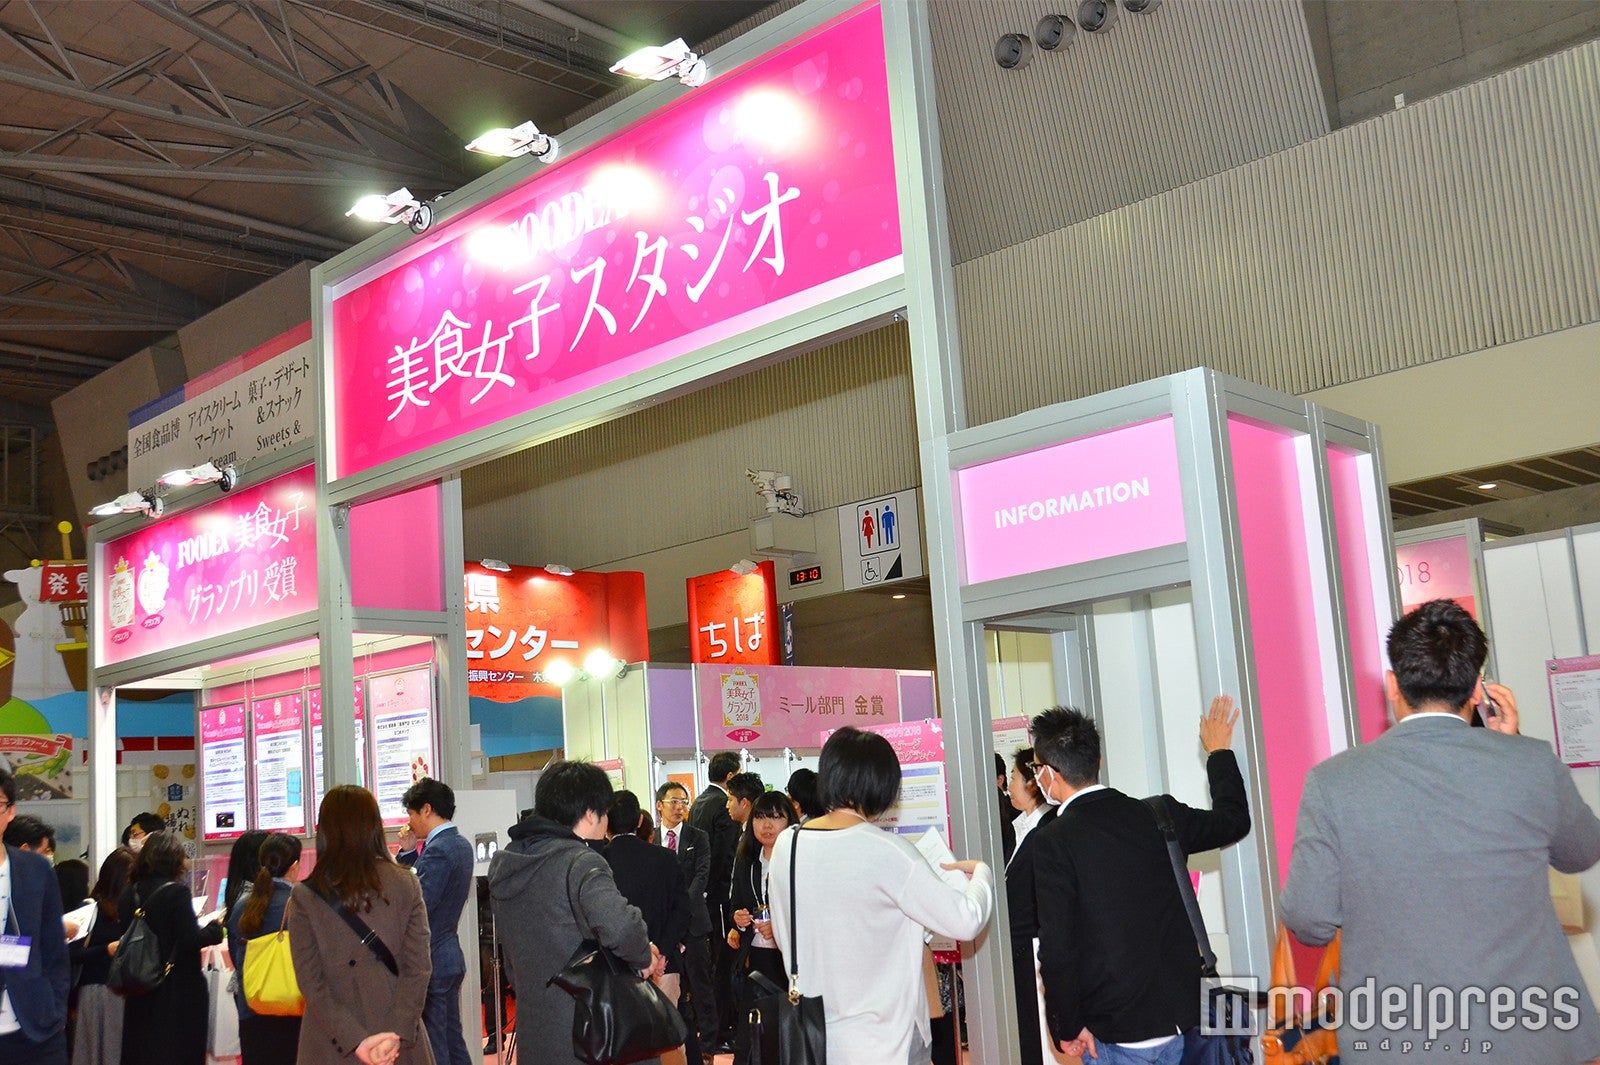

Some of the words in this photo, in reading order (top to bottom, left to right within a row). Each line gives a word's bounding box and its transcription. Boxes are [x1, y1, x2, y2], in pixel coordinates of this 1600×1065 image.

[386, 171, 801, 421] 美食女子スタジオ
[248, 357, 310, 405] 菓子・デザート
[188, 391, 241, 432] アイスクリーム
[256, 387, 302, 425] &スナック
[133, 416, 181, 458] 全国食品博
[194, 419, 234, 450] マーケット
[256, 426, 290, 451] Sweets
[294, 420, 301, 435] &
[994, 477, 1150, 529] INFORMATION
[178, 532, 231, 570] FOODEX
[234, 491, 308, 554] 美食女子
[48, 572, 88, 596] 発見
[188, 569, 259, 625] グランプリ
[264, 555, 298, 606] 受賞
[464, 573, 500, 613] 県
[796, 568, 819, 582] 13:10
[466, 625, 579, 661] センター
[700, 611, 765, 658] ちば
[727, 686, 755, 702] 美食女子
[727, 701, 757, 714] グランプリ
[779, 695, 844, 715] ミール部門
[854, 694, 885, 716] 金賞
[736, 714, 749, 722] 2018
